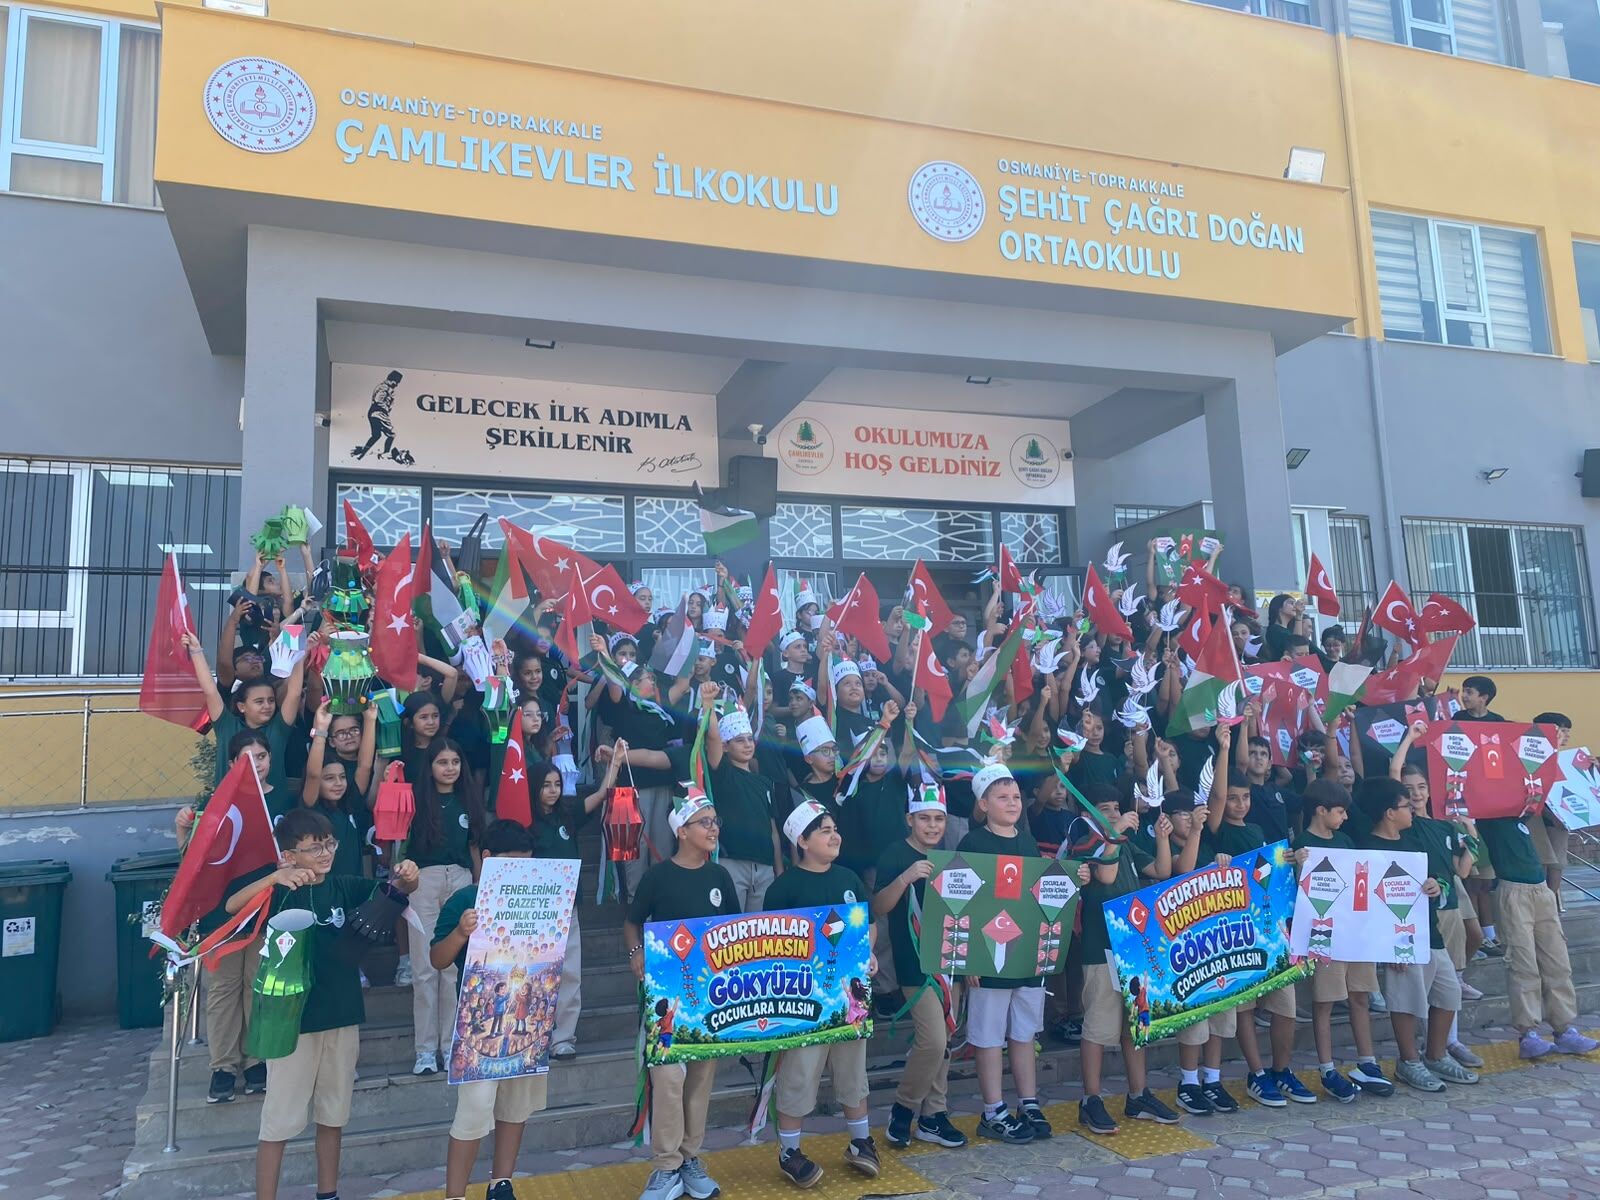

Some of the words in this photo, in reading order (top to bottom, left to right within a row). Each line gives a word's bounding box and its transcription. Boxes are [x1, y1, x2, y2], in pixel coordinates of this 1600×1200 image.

[339, 88, 602, 140] OSMANİYE-TOPRAKKALE
[335, 118, 635, 192] ÇAMLIKEVLER
[653, 152, 839, 216] İLKOKULU
[997, 158, 1185, 198] OSMANİYE-TOPRAKKALE
[998, 185, 1091, 224] ŞEHİT
[1104, 197, 1200, 239] ÇAĞRI
[1207, 211, 1304, 254] DOĞAN
[999, 229, 1181, 281] ORTAOKULU
[416, 393, 539, 421] GELECEK
[549, 399, 591, 424] İLK
[598, 409, 692, 431] ADIMLA
[485, 425, 633, 454] ŞEKİLLENİR
[854, 425, 989, 451] OKULUMUZA
[845, 452, 893, 476] HOŞ
[900, 454, 1001, 478] GELDİNİZ
[500, 882, 561, 895] FENERLERİMİZ
[507, 897, 550, 908] GAZZE'YE
[1157, 869, 1243, 916] UÇURTMALAR
[494, 911, 530, 920] AYDINLIK
[531, 910, 558, 920] OLSUN
[1164, 889, 1245, 936] VURULMASIN
[705, 917, 810, 949] UÇURTMALAR
[1169, 914, 1255, 973] GÖKYÜZÜ
[710, 939, 809, 969] VURULMASIN
[708, 963, 813, 1006] GÖKYÜZÜ
[1176, 960, 1229, 998] ÇOCUKLARA
[1230, 953, 1262, 967] KALSIN
[711, 1001, 774, 1030] ÇOCUKLARA
[778, 1001, 814, 1016] KALSIN
